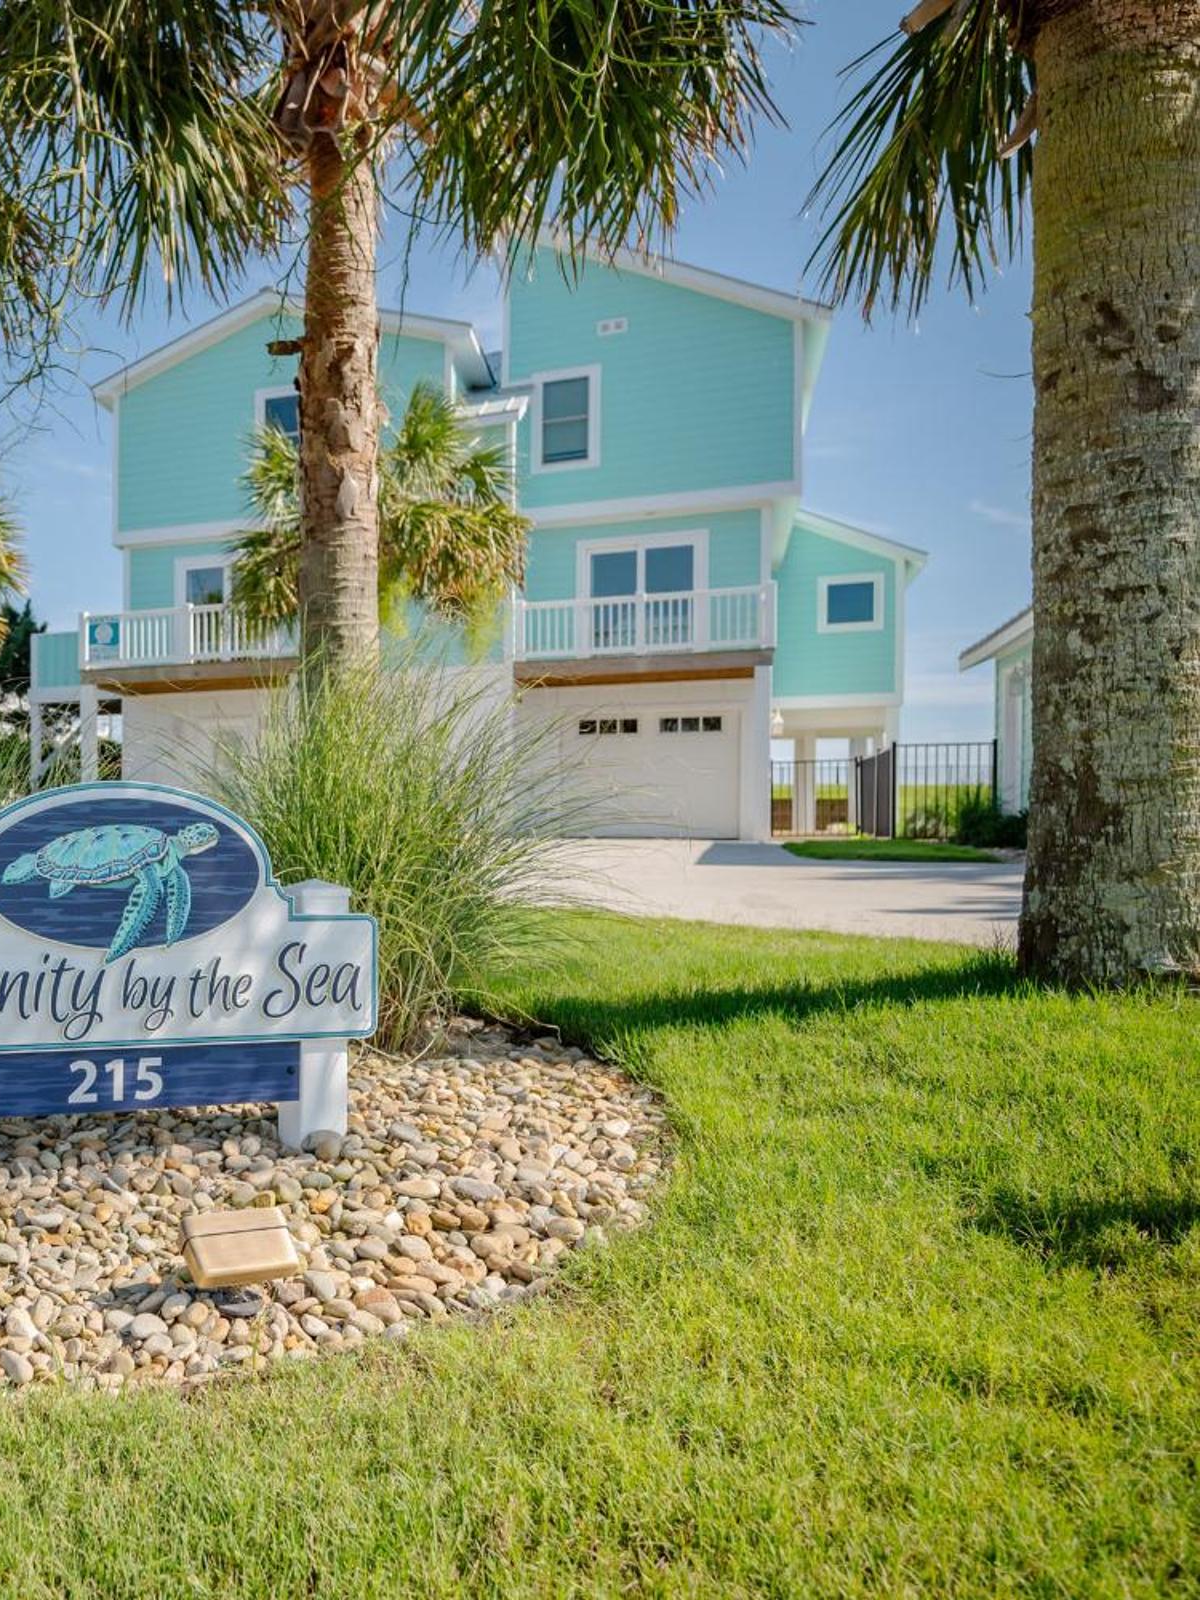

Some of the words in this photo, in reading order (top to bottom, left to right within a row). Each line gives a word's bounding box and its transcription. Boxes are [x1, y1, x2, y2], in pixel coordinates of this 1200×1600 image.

[123, 959, 177, 1032] by
[189, 956, 250, 1018] the
[263, 941, 362, 1018] Sea
[67, 1057, 164, 1104] 215
